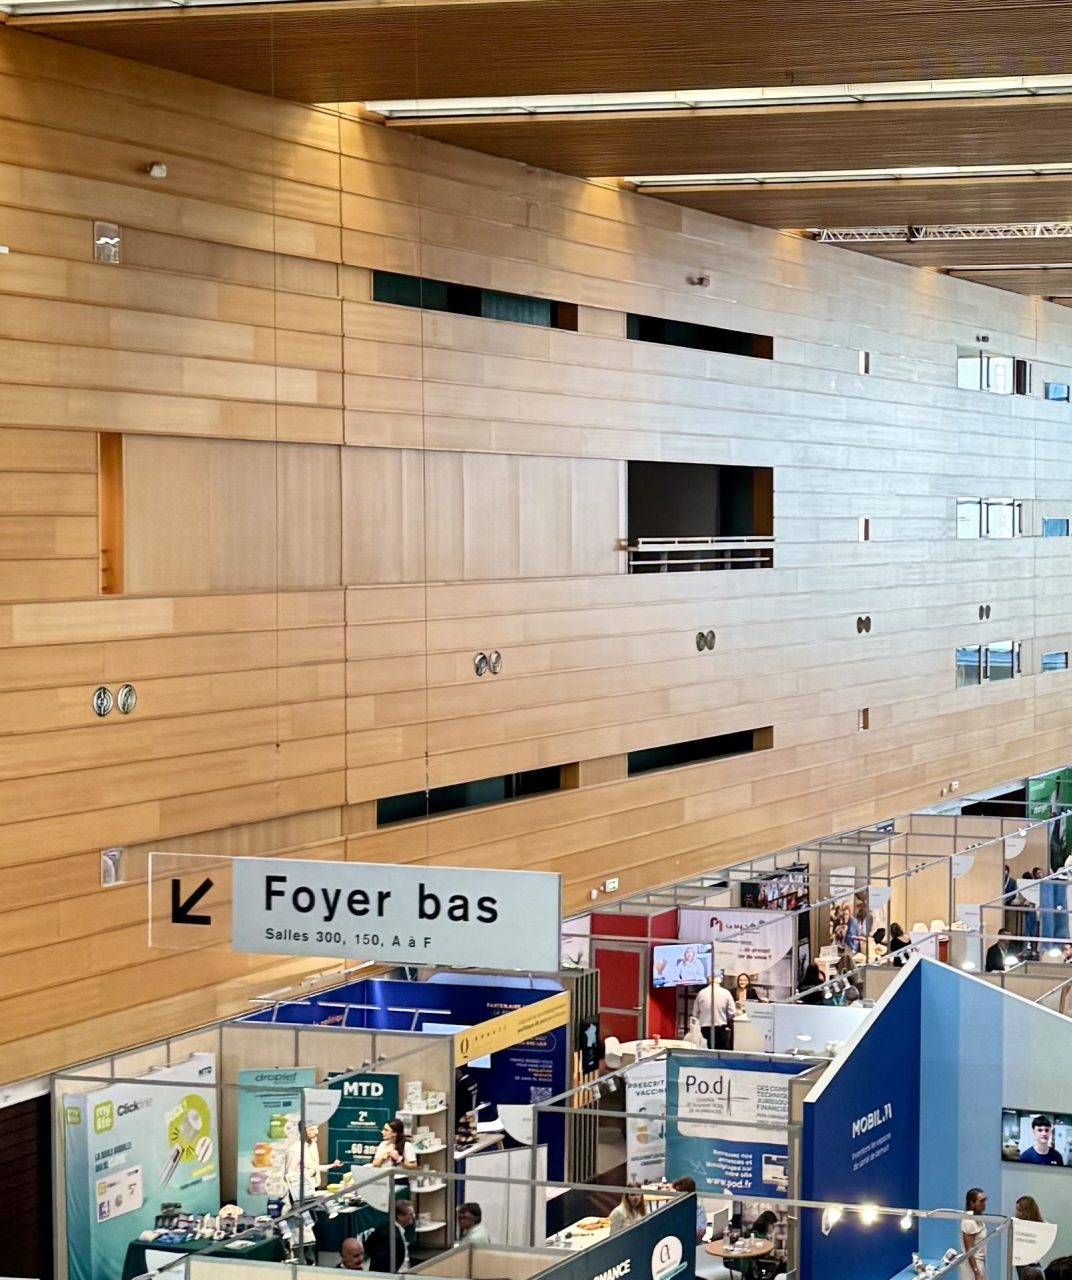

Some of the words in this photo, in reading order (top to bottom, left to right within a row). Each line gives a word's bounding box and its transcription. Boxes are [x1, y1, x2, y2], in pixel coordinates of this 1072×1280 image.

[265, 875, 391, 922] Foyer
[418, 883, 498, 923] bas
[265, 928, 309, 942] Salles
[316, 931, 346, 945] 300,
[355, 934, 384, 947] 150,
[392, 935, 401, 947] A
[408, 936, 416, 948] à
[424, 937, 432, 948] F
[343, 1081, 384, 1097] MTD
